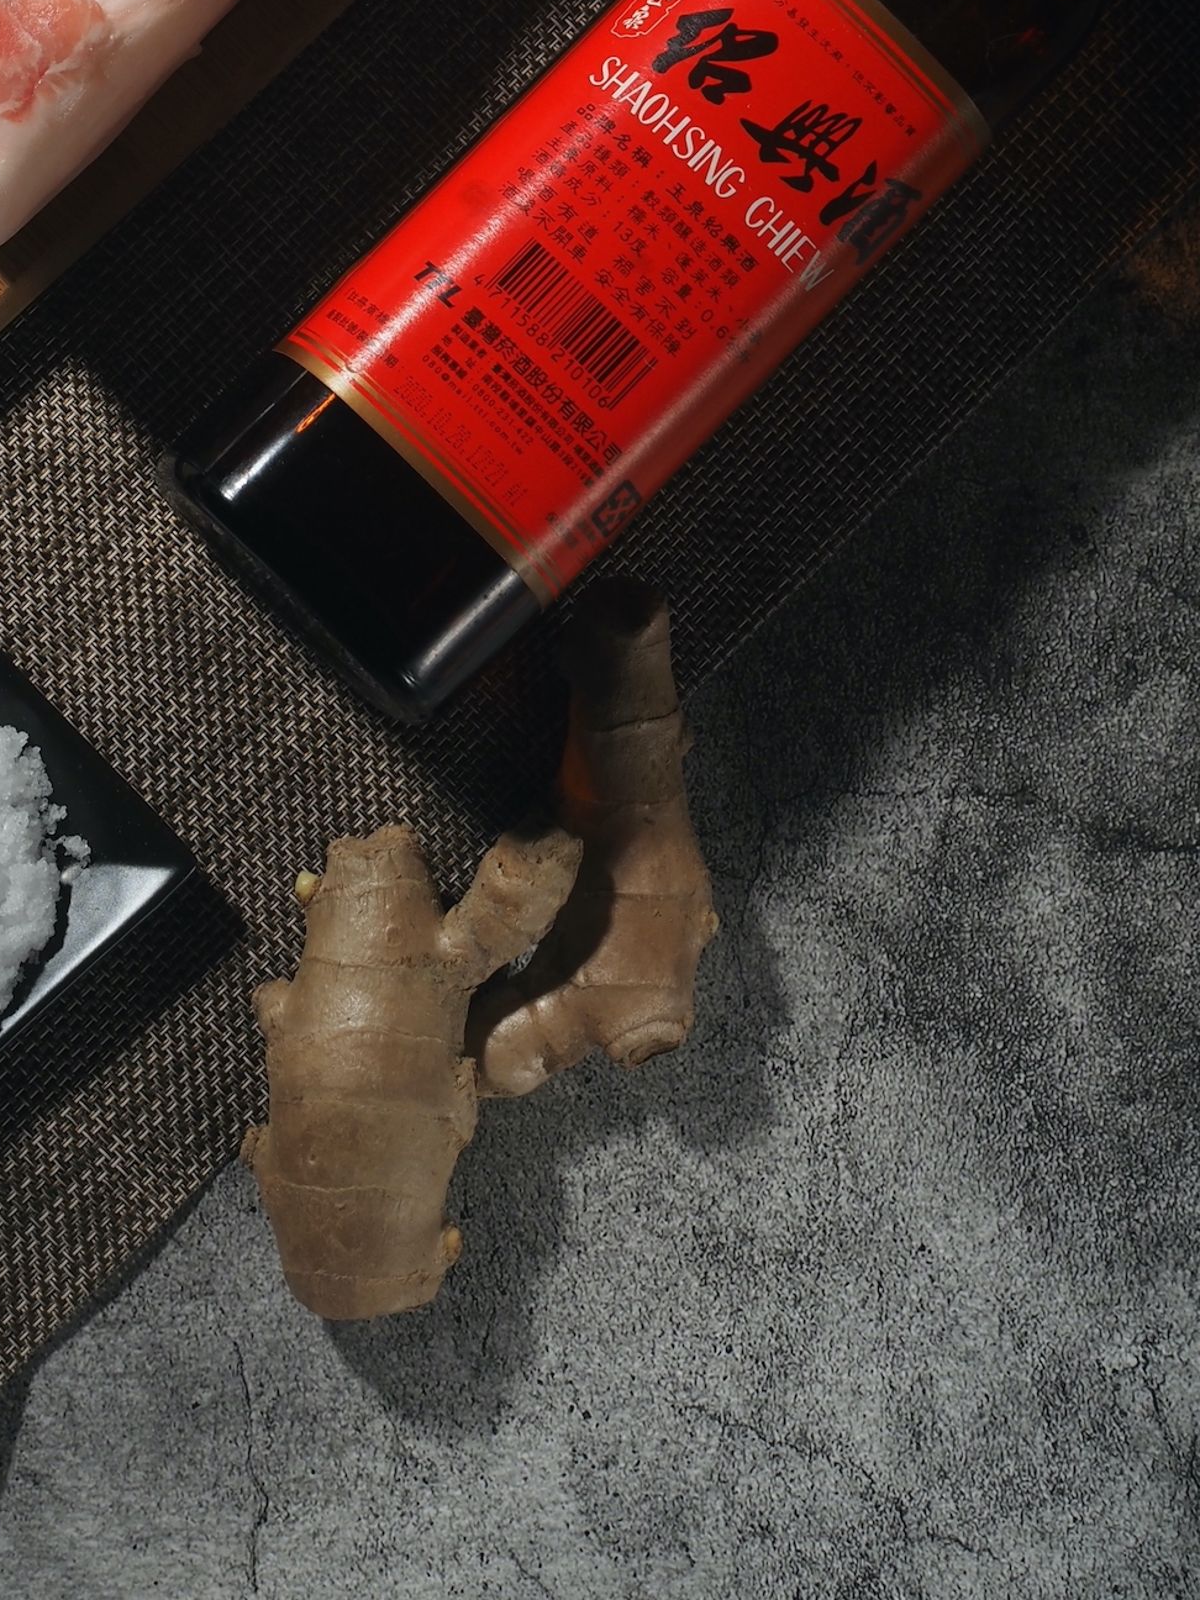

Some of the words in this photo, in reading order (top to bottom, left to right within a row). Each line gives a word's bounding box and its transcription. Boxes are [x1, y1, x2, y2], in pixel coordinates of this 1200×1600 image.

[587, 55, 748, 200] SHAOHSING
[746, 194, 835, 293] CHIEW
[651, 9, 923, 267] 紹興酒
[460, 305, 624, 467] 臺灣菸酒股份有限公司
